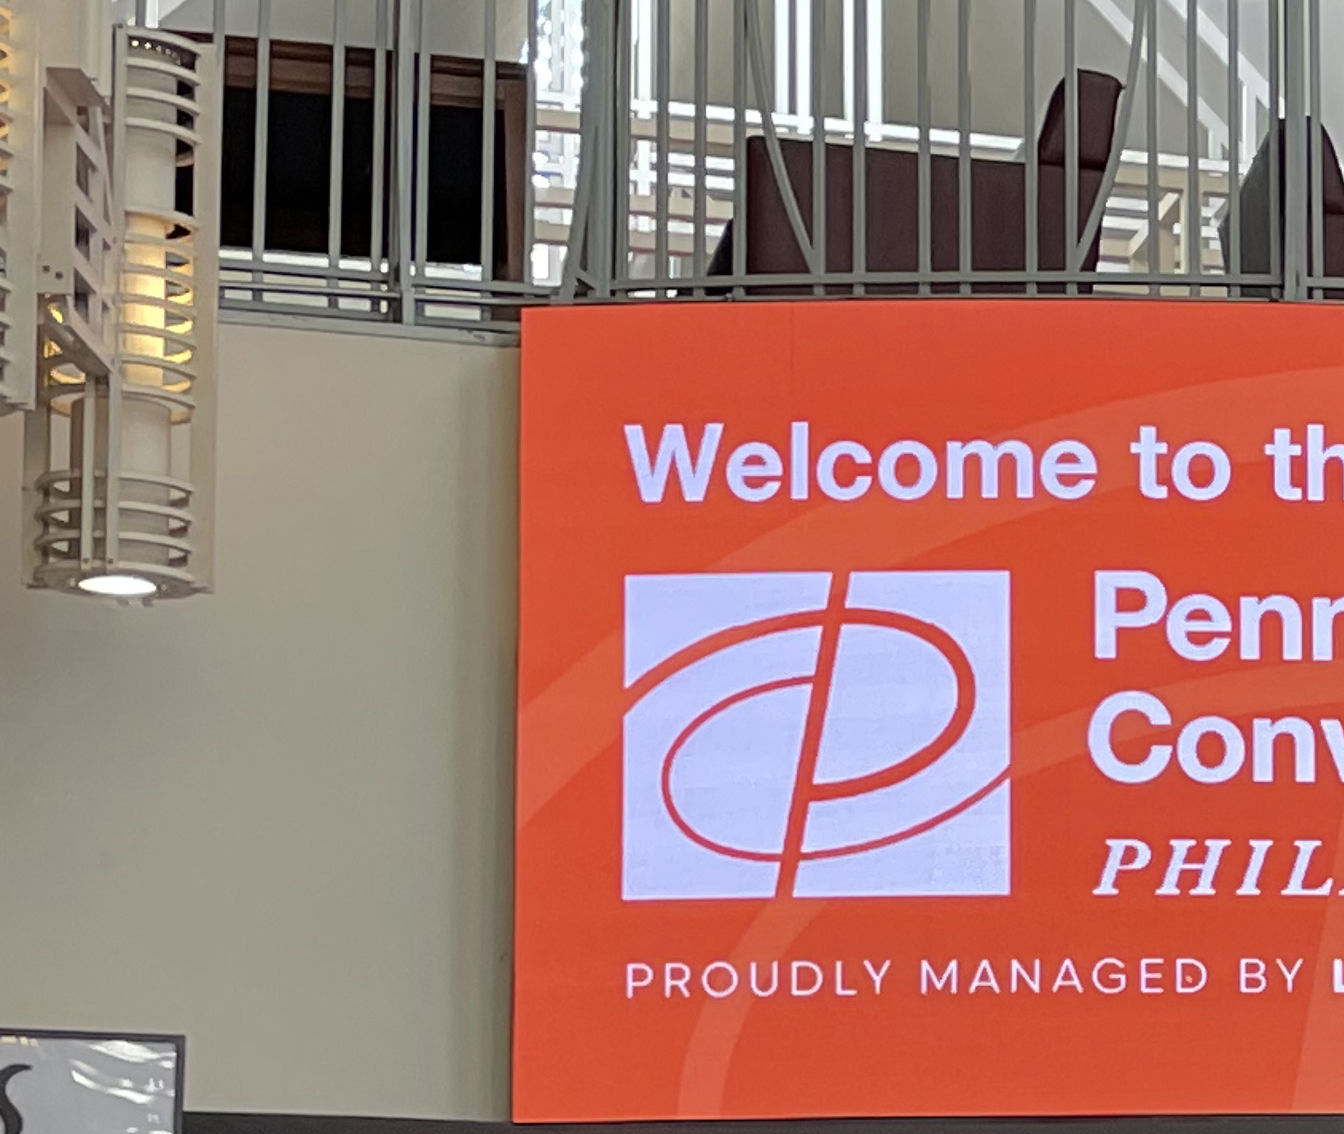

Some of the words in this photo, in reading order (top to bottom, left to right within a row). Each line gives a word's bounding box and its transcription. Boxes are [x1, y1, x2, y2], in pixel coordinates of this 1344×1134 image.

[624, 421, 1098, 504] Welcome
[1130, 425, 1232, 501] to
[626, 960, 891, 999] PROUDLY
[920, 957, 1208, 995] MANAGED
[1239, 958, 1304, 993] BY
